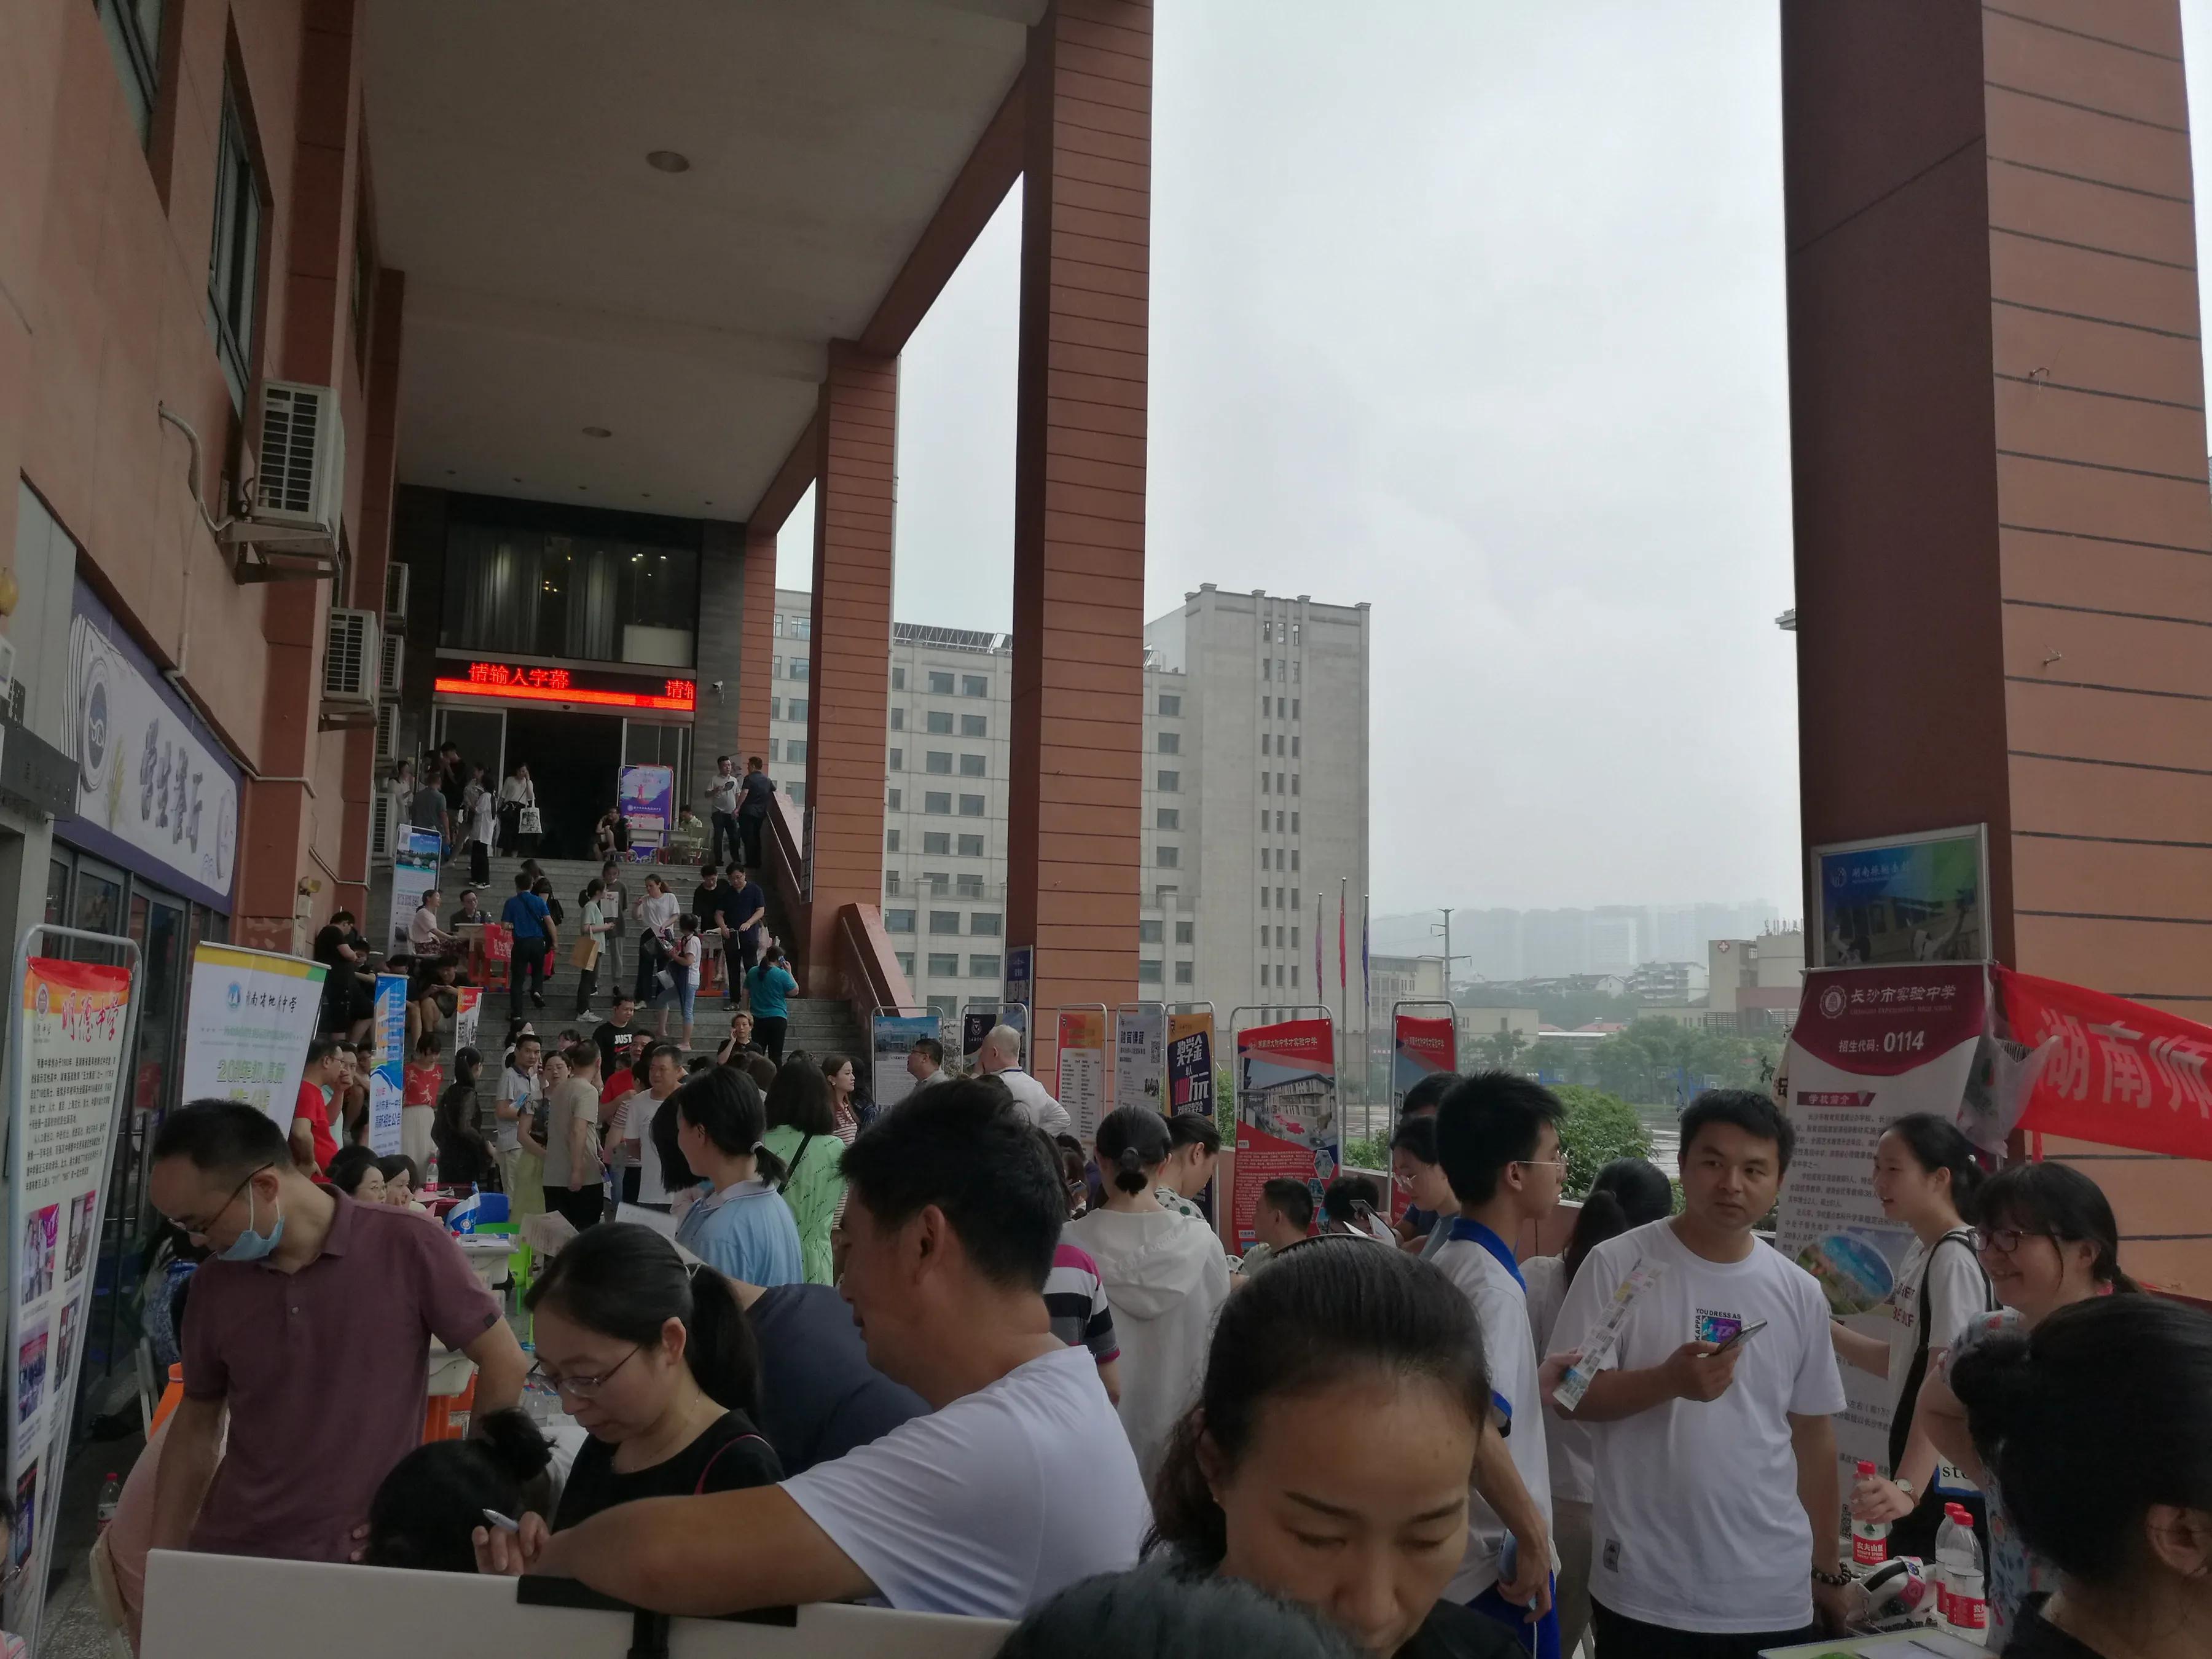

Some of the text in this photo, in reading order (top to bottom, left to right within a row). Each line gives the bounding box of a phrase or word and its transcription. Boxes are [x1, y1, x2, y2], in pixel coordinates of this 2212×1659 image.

[469, 662, 570, 689] 请输入字幕
[1851, 984, 1956, 1003] 长沙市实验中学
[614, 1034, 633, 1045] JUST
[1883, 1030, 1925, 1053] 0114
[1177, 1035, 1203, 1067] 奖学金
[1808, 1094, 1849, 1105] 学校简介
[1857, 1541, 1883, 1552] 农夫山泉
